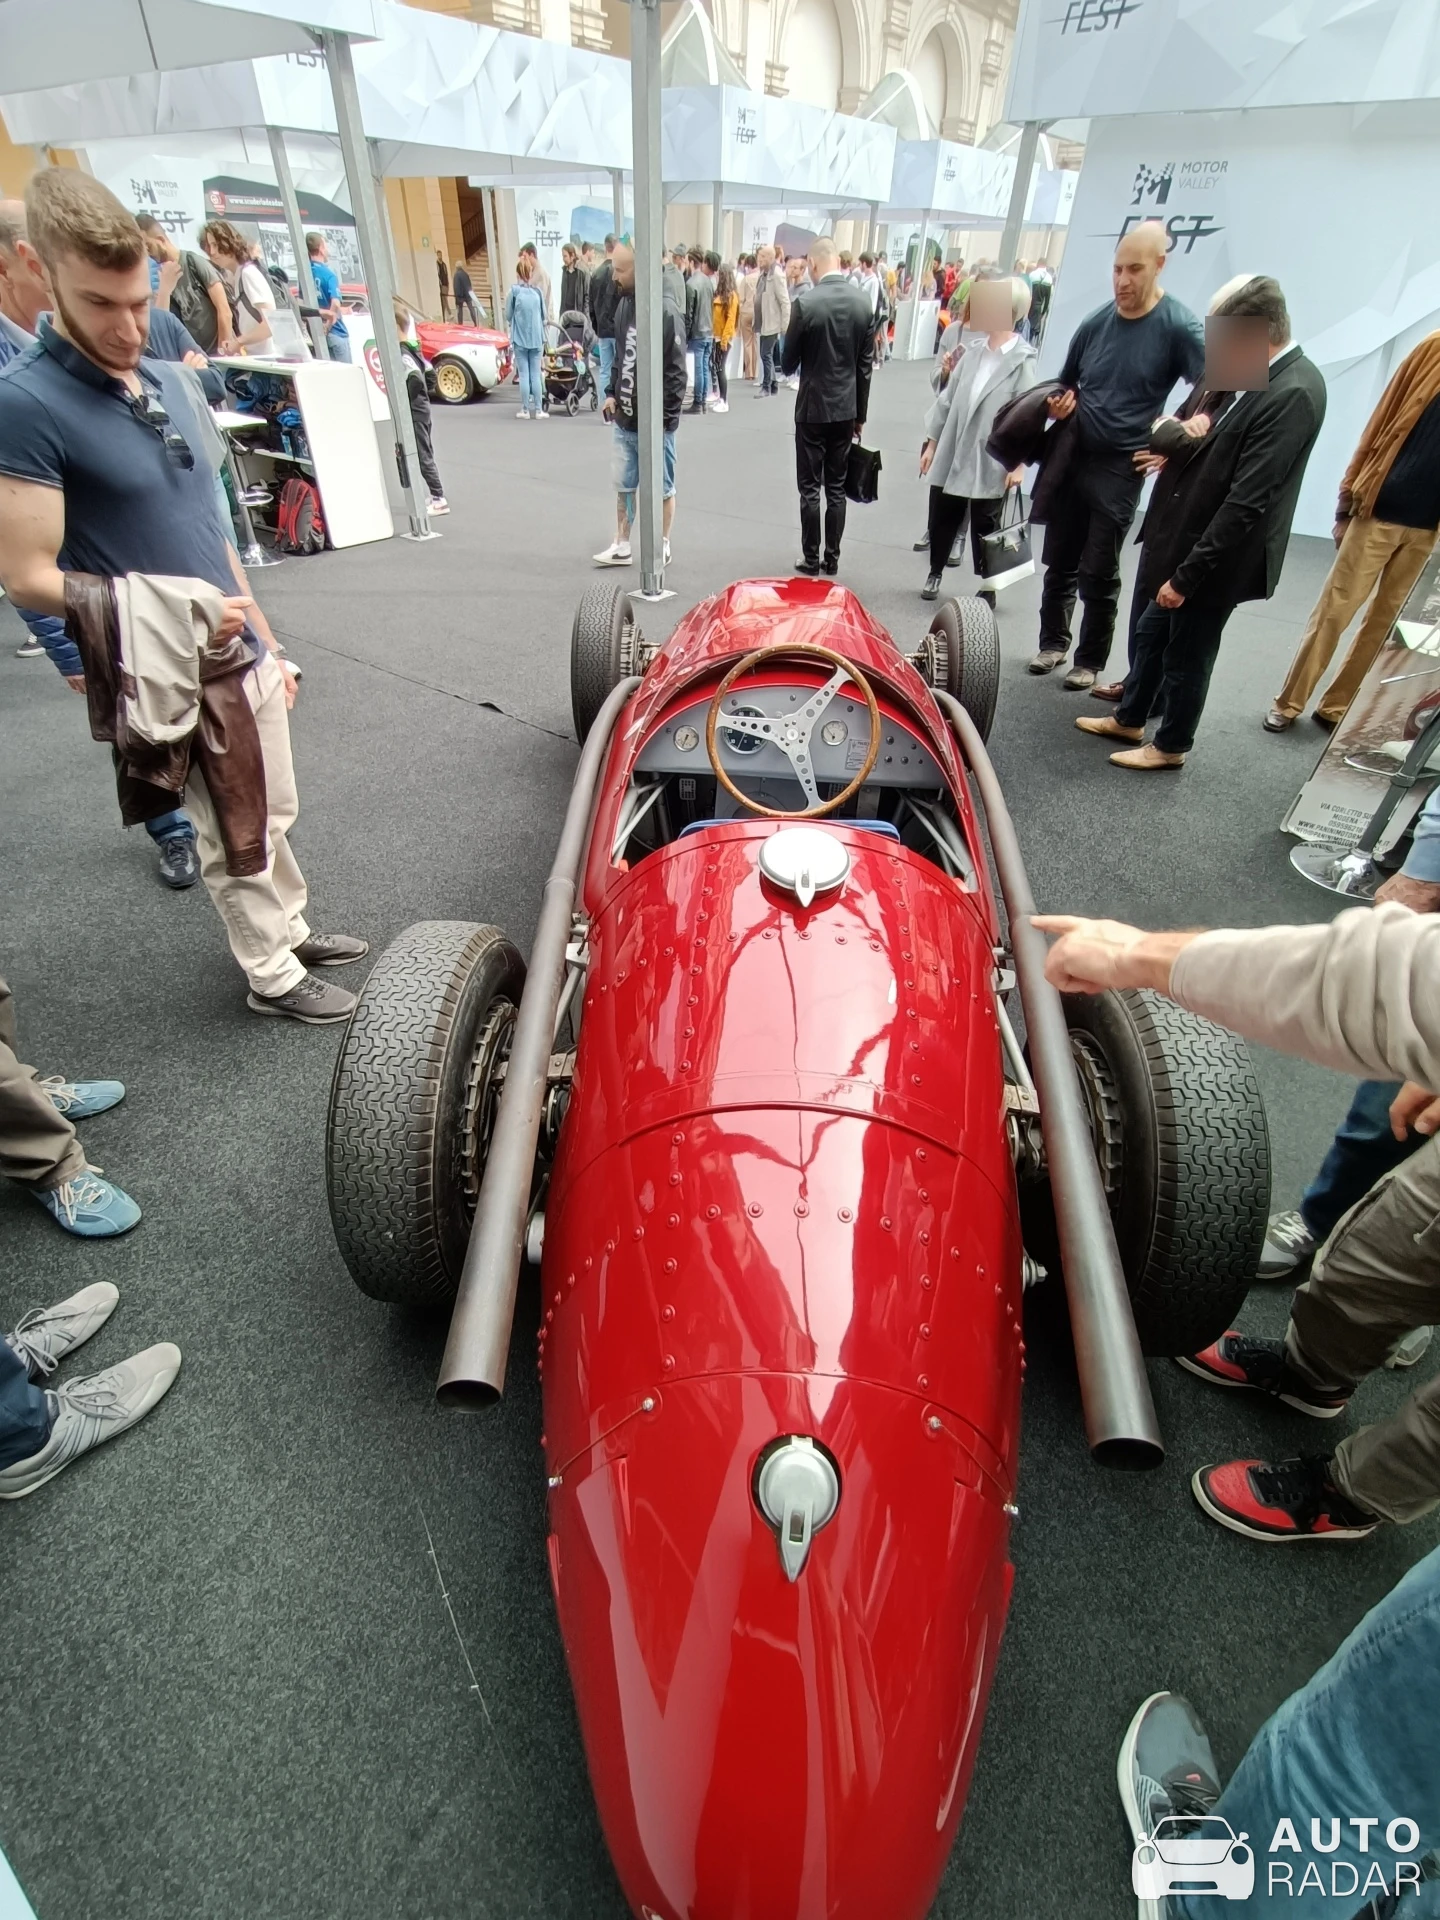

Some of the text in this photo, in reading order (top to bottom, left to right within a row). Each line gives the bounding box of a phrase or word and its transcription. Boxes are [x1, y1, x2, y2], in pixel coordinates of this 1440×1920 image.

[1181, 161, 1229, 174] MOTOR
[153, 180, 179, 190] MOTOR
[1178, 177, 1220, 190] VALLEY
[535, 230, 561, 247] FEST
[1114, 215, 1215, 254] FST
[1320, 802, 1331, 811] VIA
[1331, 804, 1363, 818] CORLETTO
[1331, 813, 1359, 825] MODENA
[1327, 820, 1364, 833] 059596218
